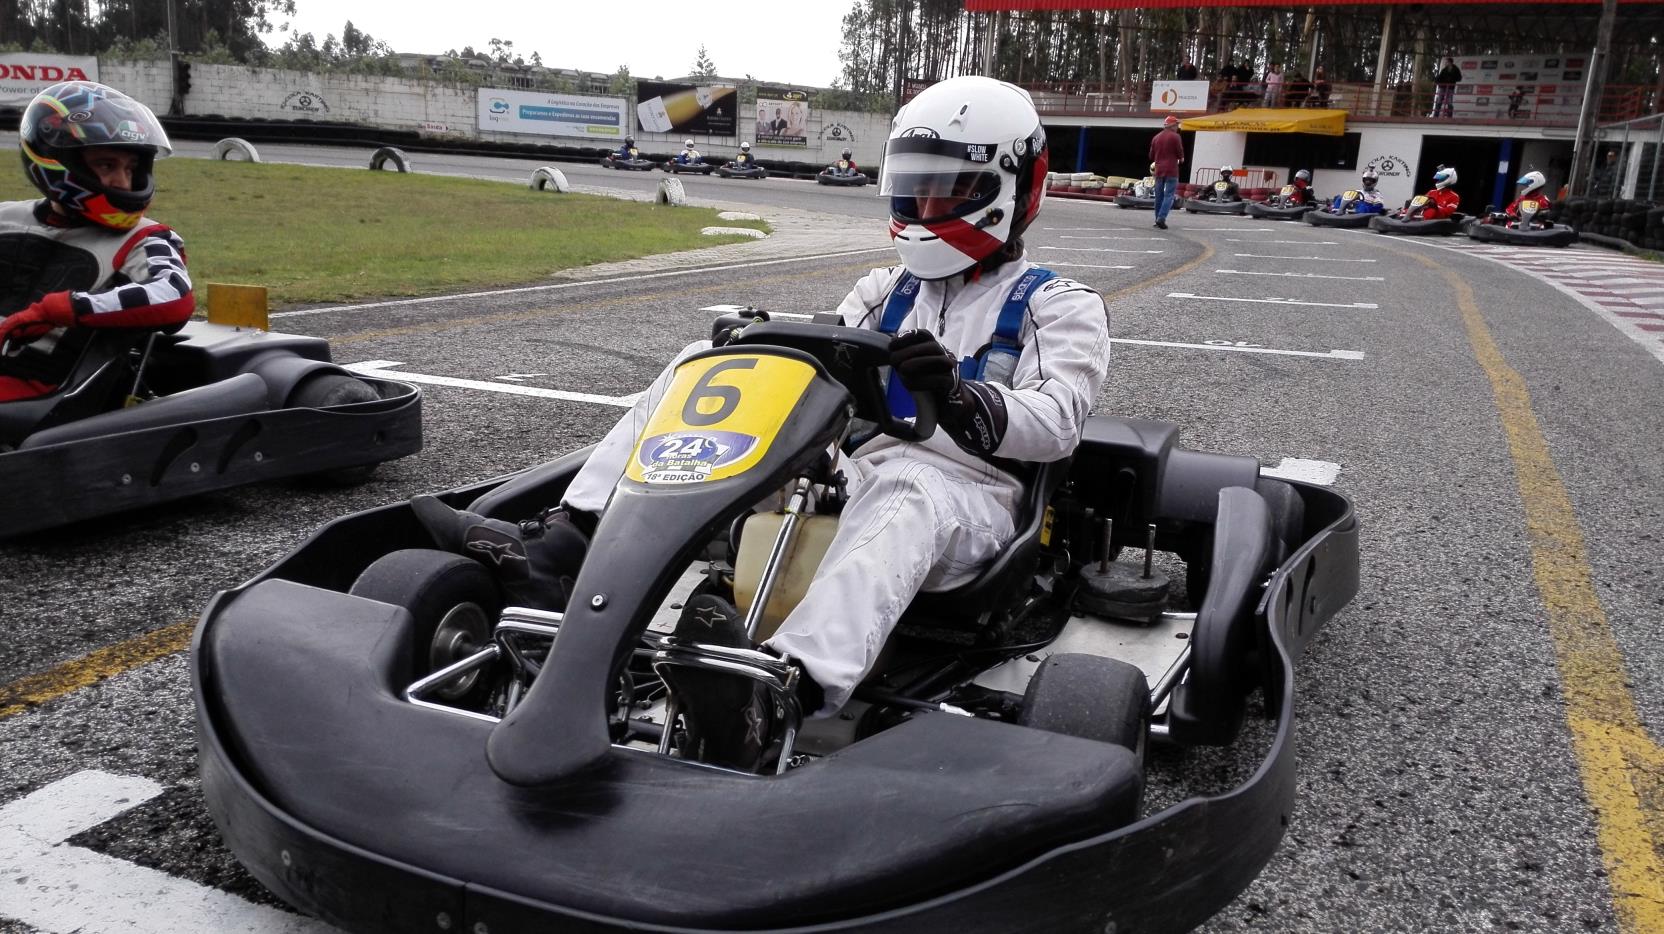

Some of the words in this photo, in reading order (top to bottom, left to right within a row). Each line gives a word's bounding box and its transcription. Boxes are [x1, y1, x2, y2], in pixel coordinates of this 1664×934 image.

[0, 86, 27, 94] ower
[967, 144, 987, 154] #SLOW
[970, 153, 988, 162] WHITE
[682, 358, 759, 426] 6
[658, 438, 704, 458] 24
[663, 471, 704, 481] EDIÇÃO
